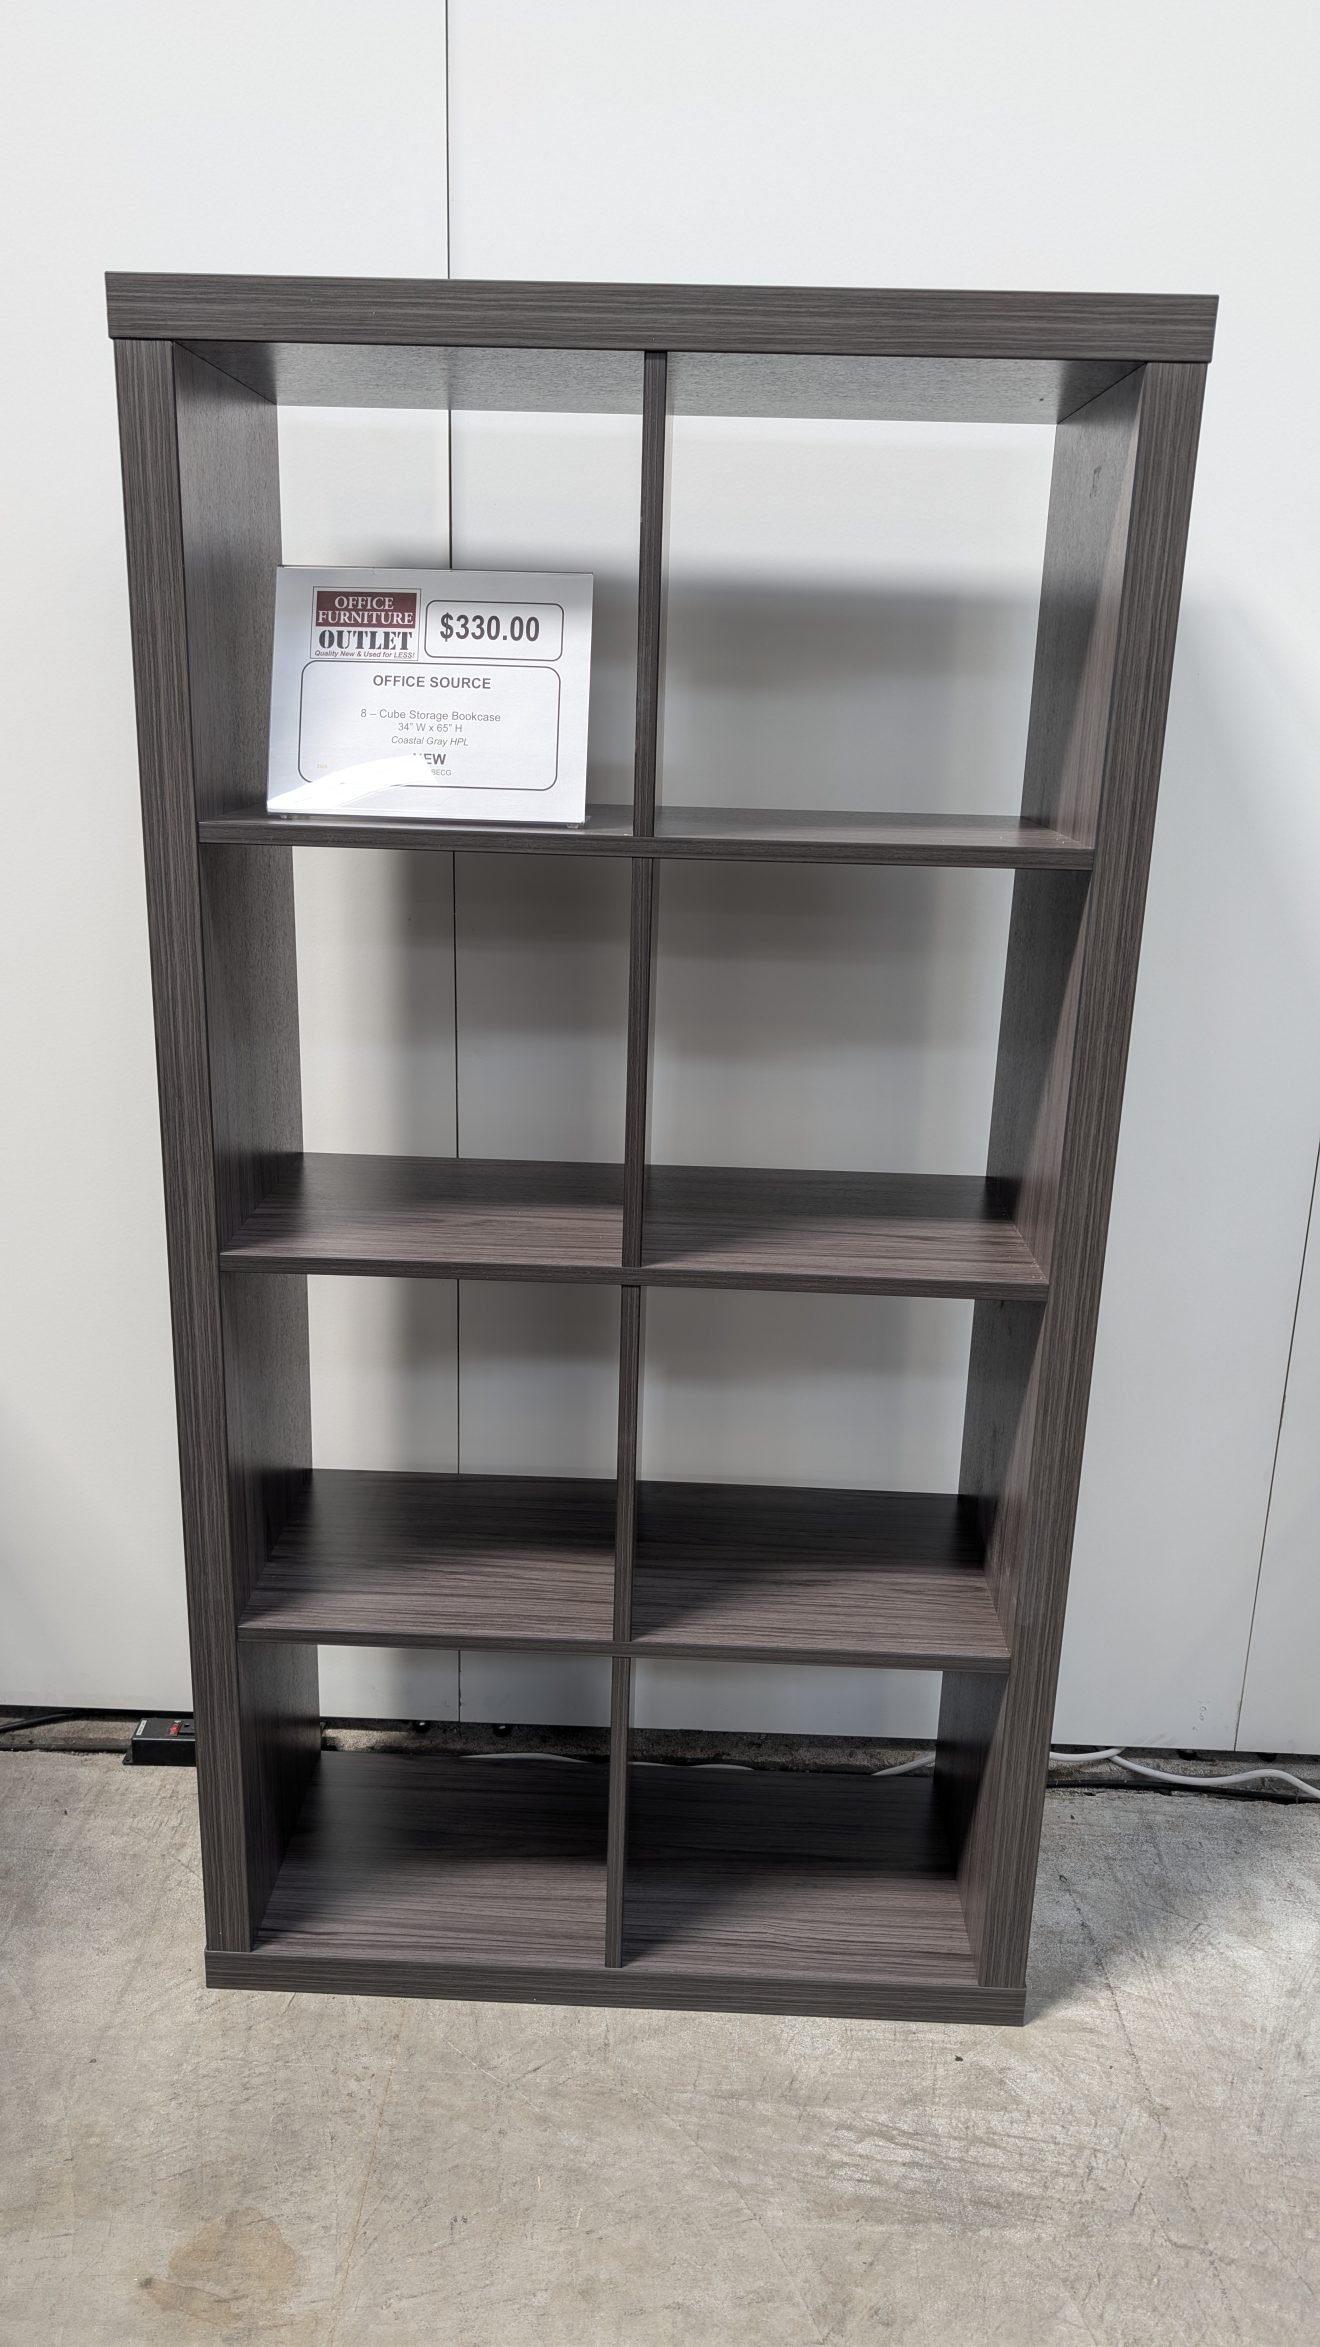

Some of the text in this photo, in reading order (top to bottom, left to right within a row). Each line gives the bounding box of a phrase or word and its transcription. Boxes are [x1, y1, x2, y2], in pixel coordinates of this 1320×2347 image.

[334, 595, 394, 610] OFFICE
[317, 610, 414, 625] FURNITURE
[439, 612, 540, 642] $330.00
[318, 629, 413, 651] OUTLET
[314, 650, 339, 658] Quality
[393, 651, 415, 659] LESS!
[372, 674, 492, 690] OFFICE SOURCE
[360, 708, 367, 718] 8
[379, 708, 406, 719] Cube
[408, 709, 449, 722] Storage
[451, 711, 501, 722] Bookcase
[416, 723, 427, 732] W
[455, 724, 463, 733] H
[391, 735, 469, 747] Coastal Gray HPL
